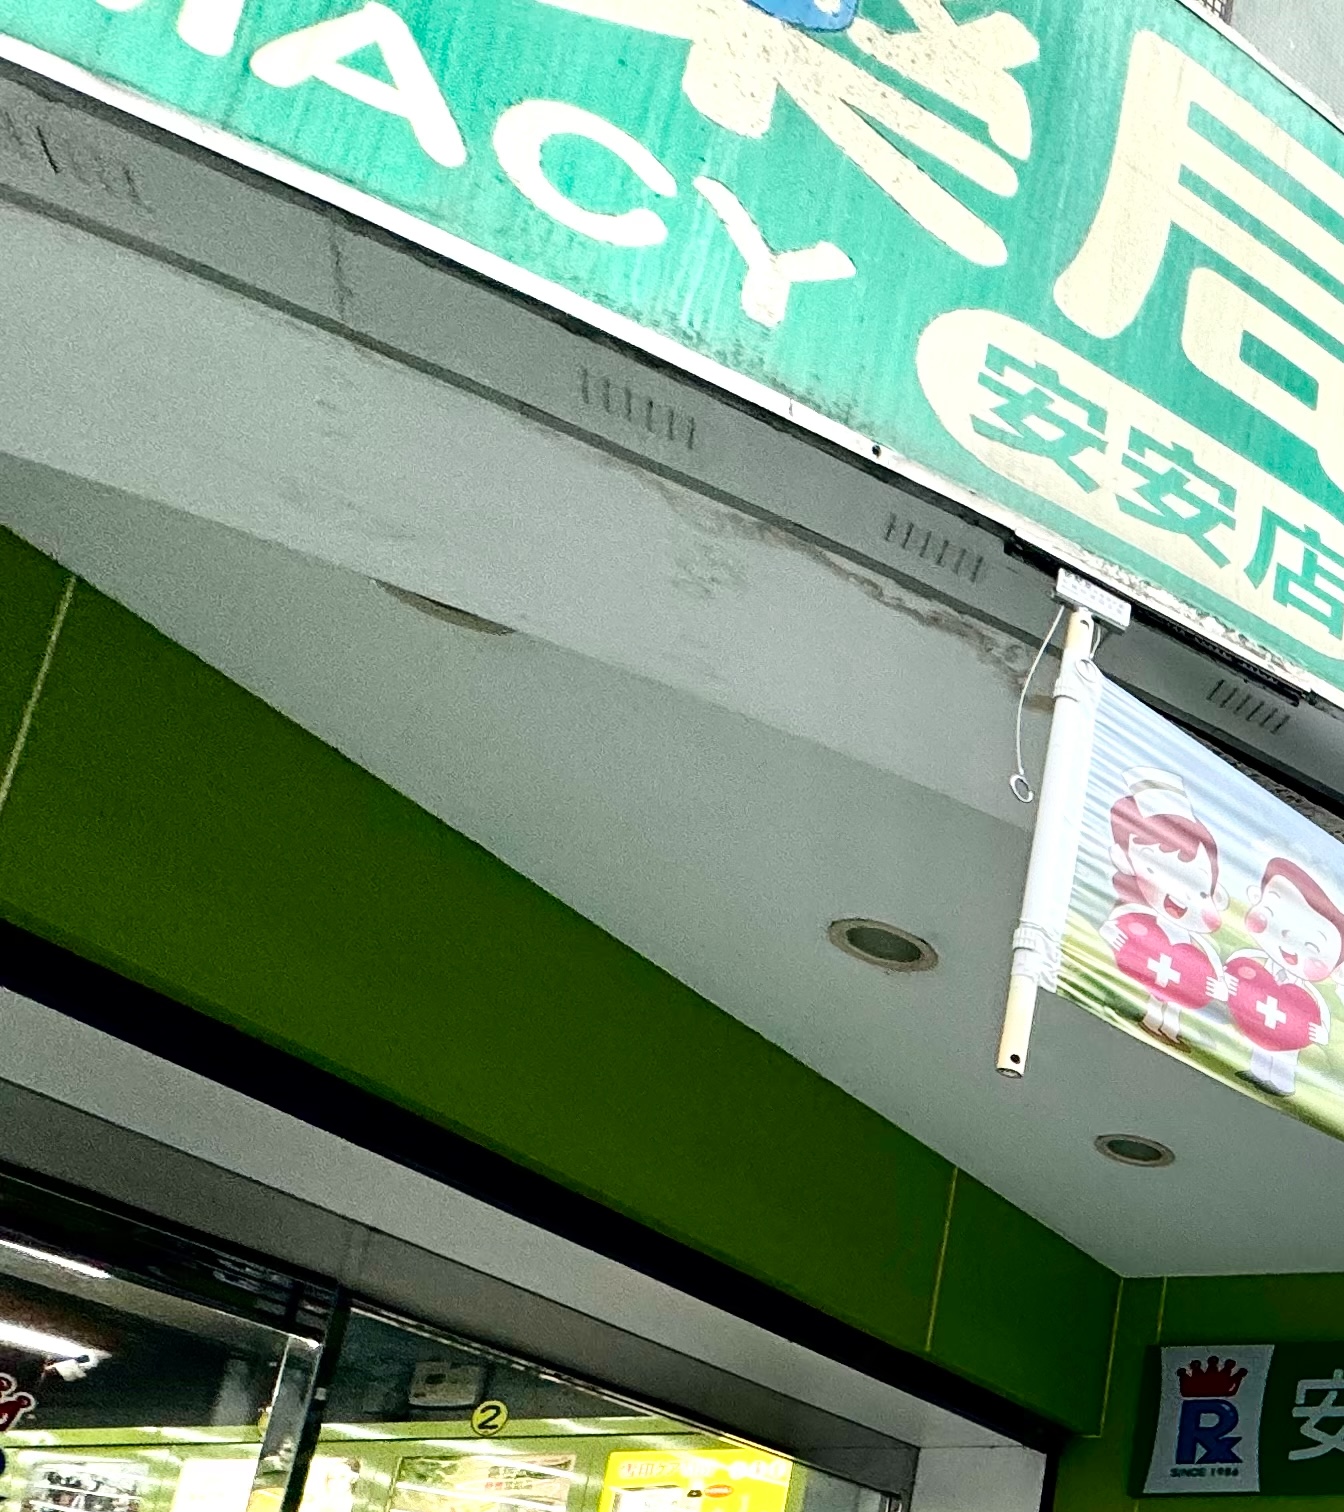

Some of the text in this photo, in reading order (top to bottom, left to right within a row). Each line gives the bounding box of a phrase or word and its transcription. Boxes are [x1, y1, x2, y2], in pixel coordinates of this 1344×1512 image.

[92, 0, 858, 328] ACY
[476, 1405, 501, 1431] 2
[1170, 1467, 1207, 1478] SINCE
